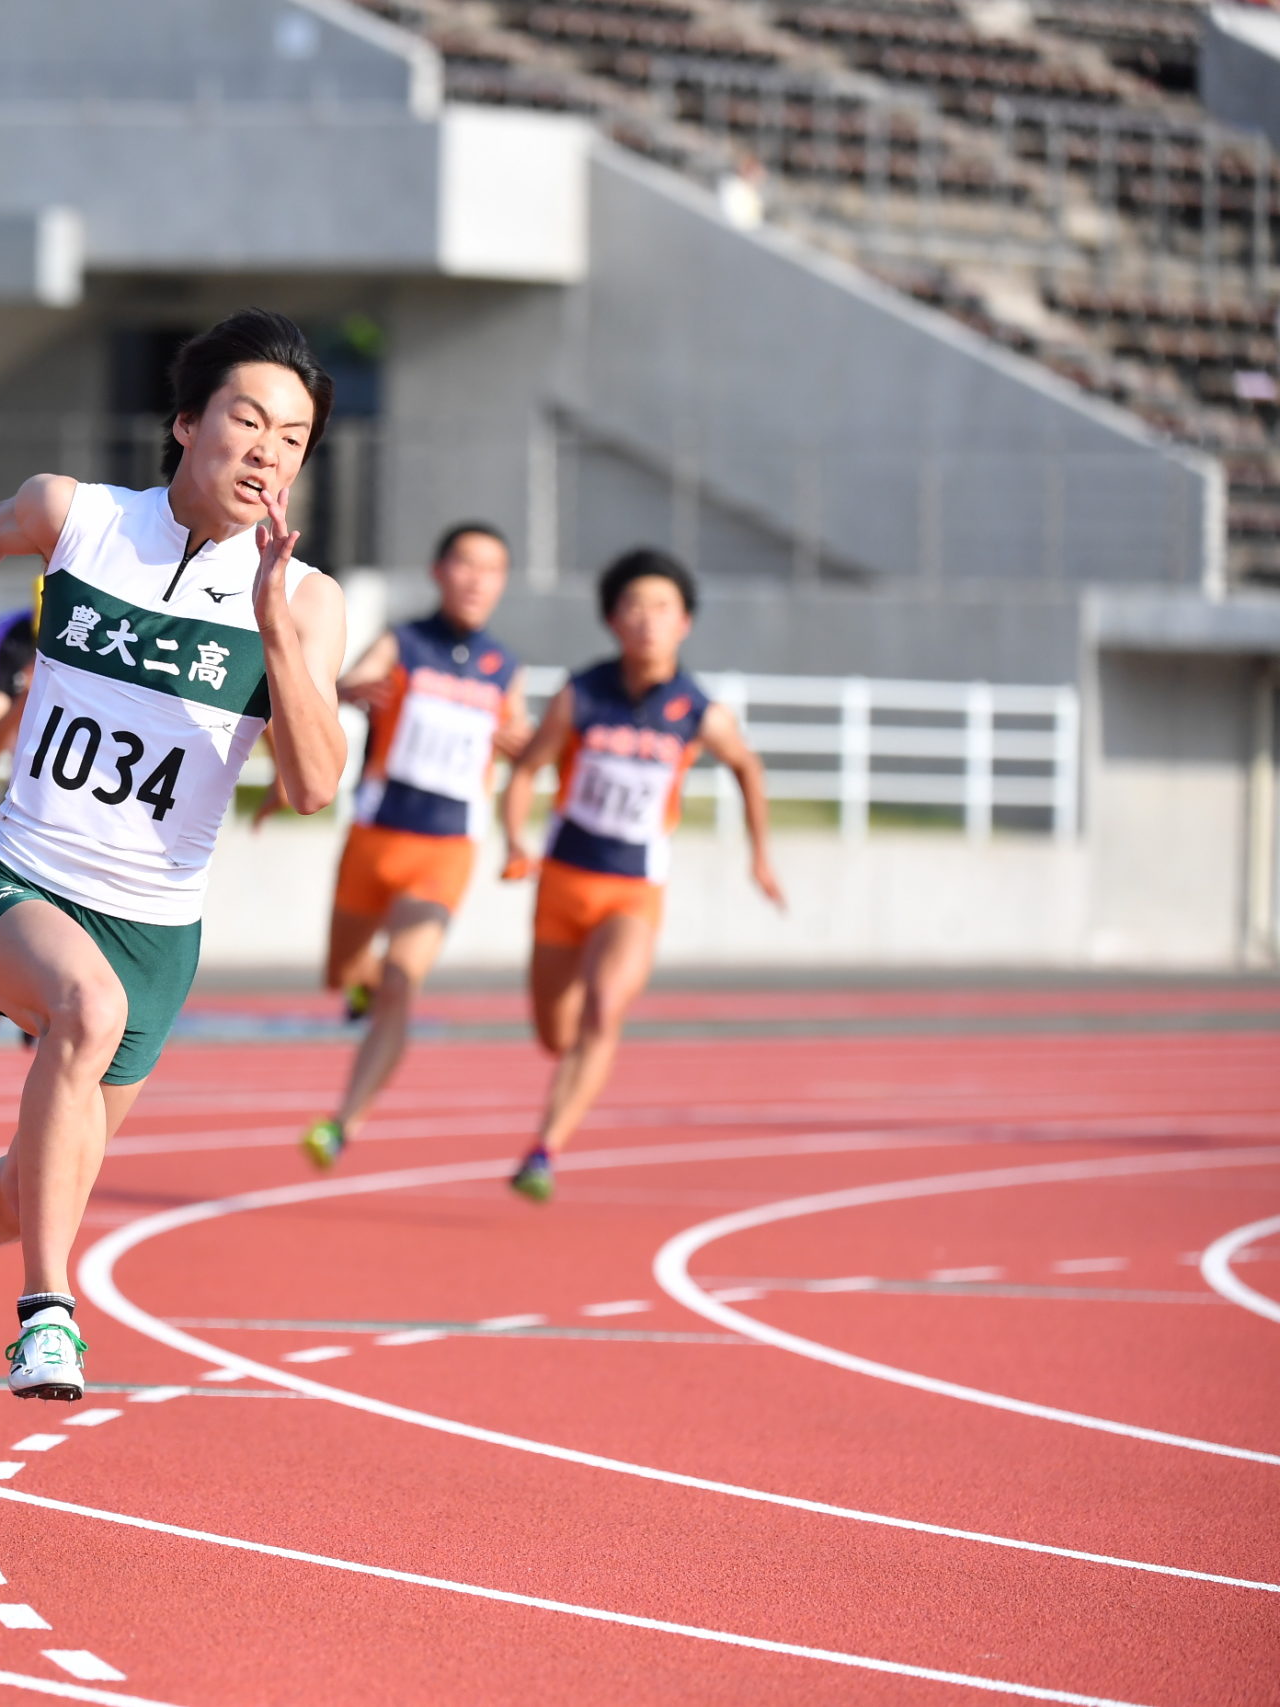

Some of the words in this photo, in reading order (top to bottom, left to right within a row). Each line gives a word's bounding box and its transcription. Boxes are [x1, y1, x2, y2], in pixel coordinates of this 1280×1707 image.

[56, 604, 231, 691] 農大二高
[29, 705, 186, 821] 1034
